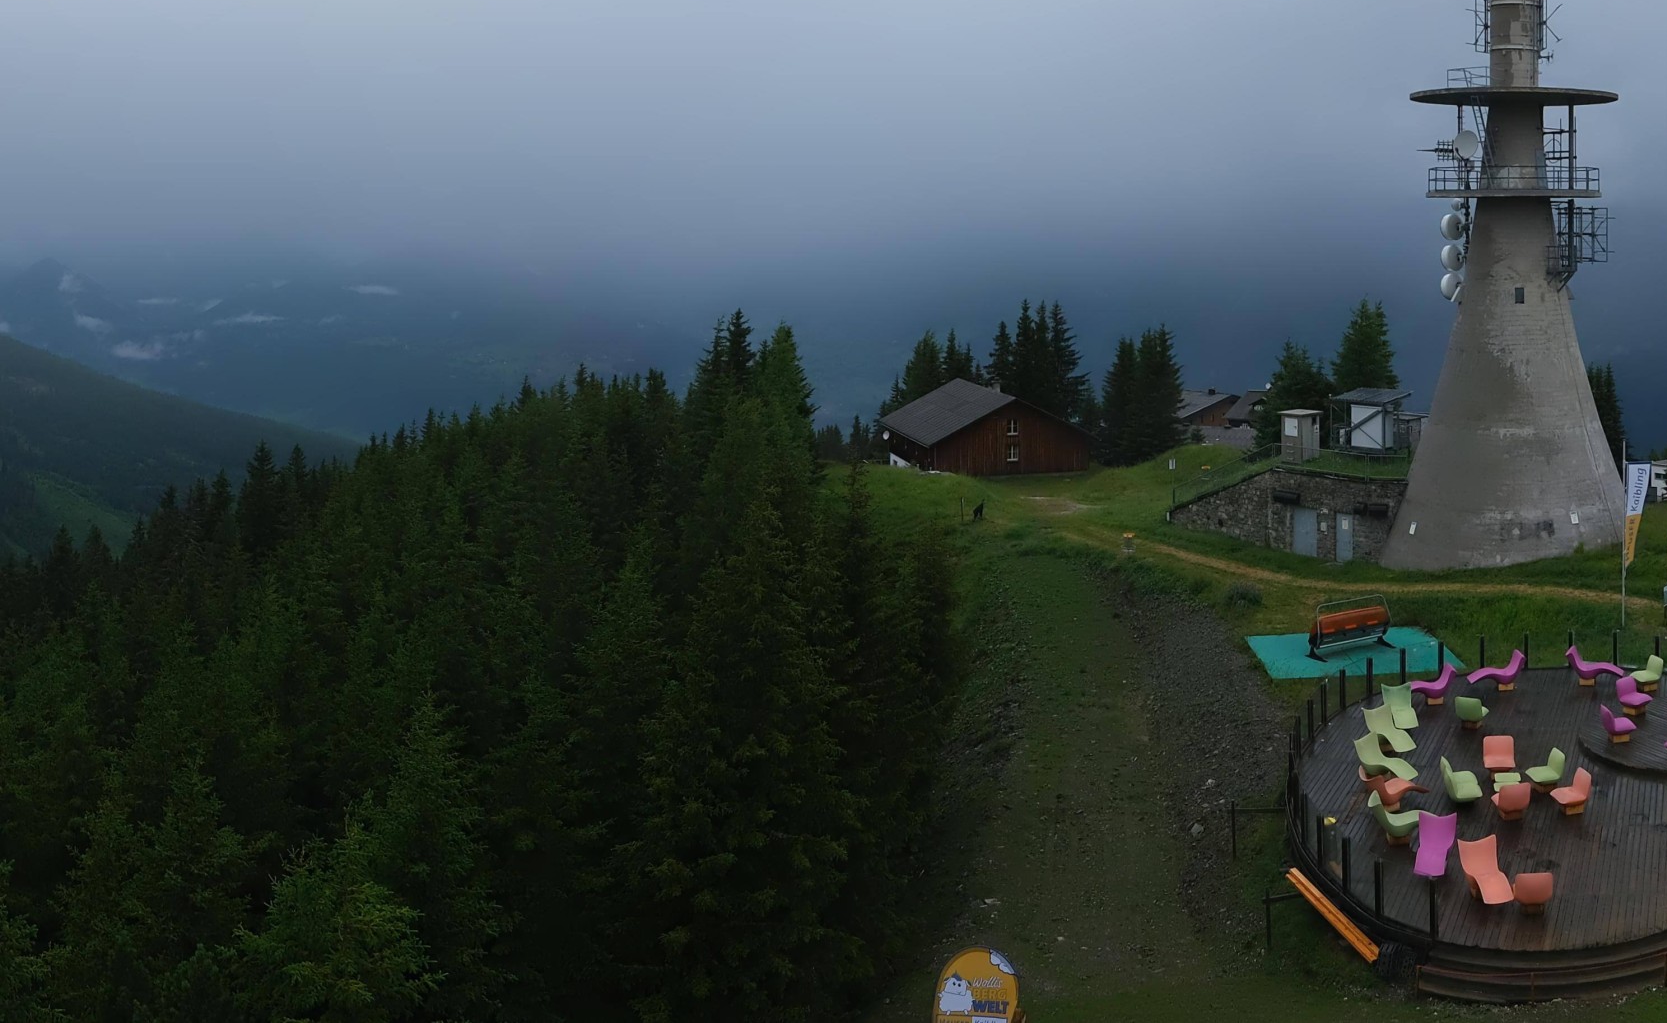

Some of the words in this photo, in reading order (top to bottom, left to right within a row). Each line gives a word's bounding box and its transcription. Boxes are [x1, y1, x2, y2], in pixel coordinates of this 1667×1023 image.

[1630, 467, 1647, 512] Kaibling
[972, 976, 1003, 988] Wollis
[972, 988, 1008, 1000] BERG
[972, 999, 1009, 1014] WELT
